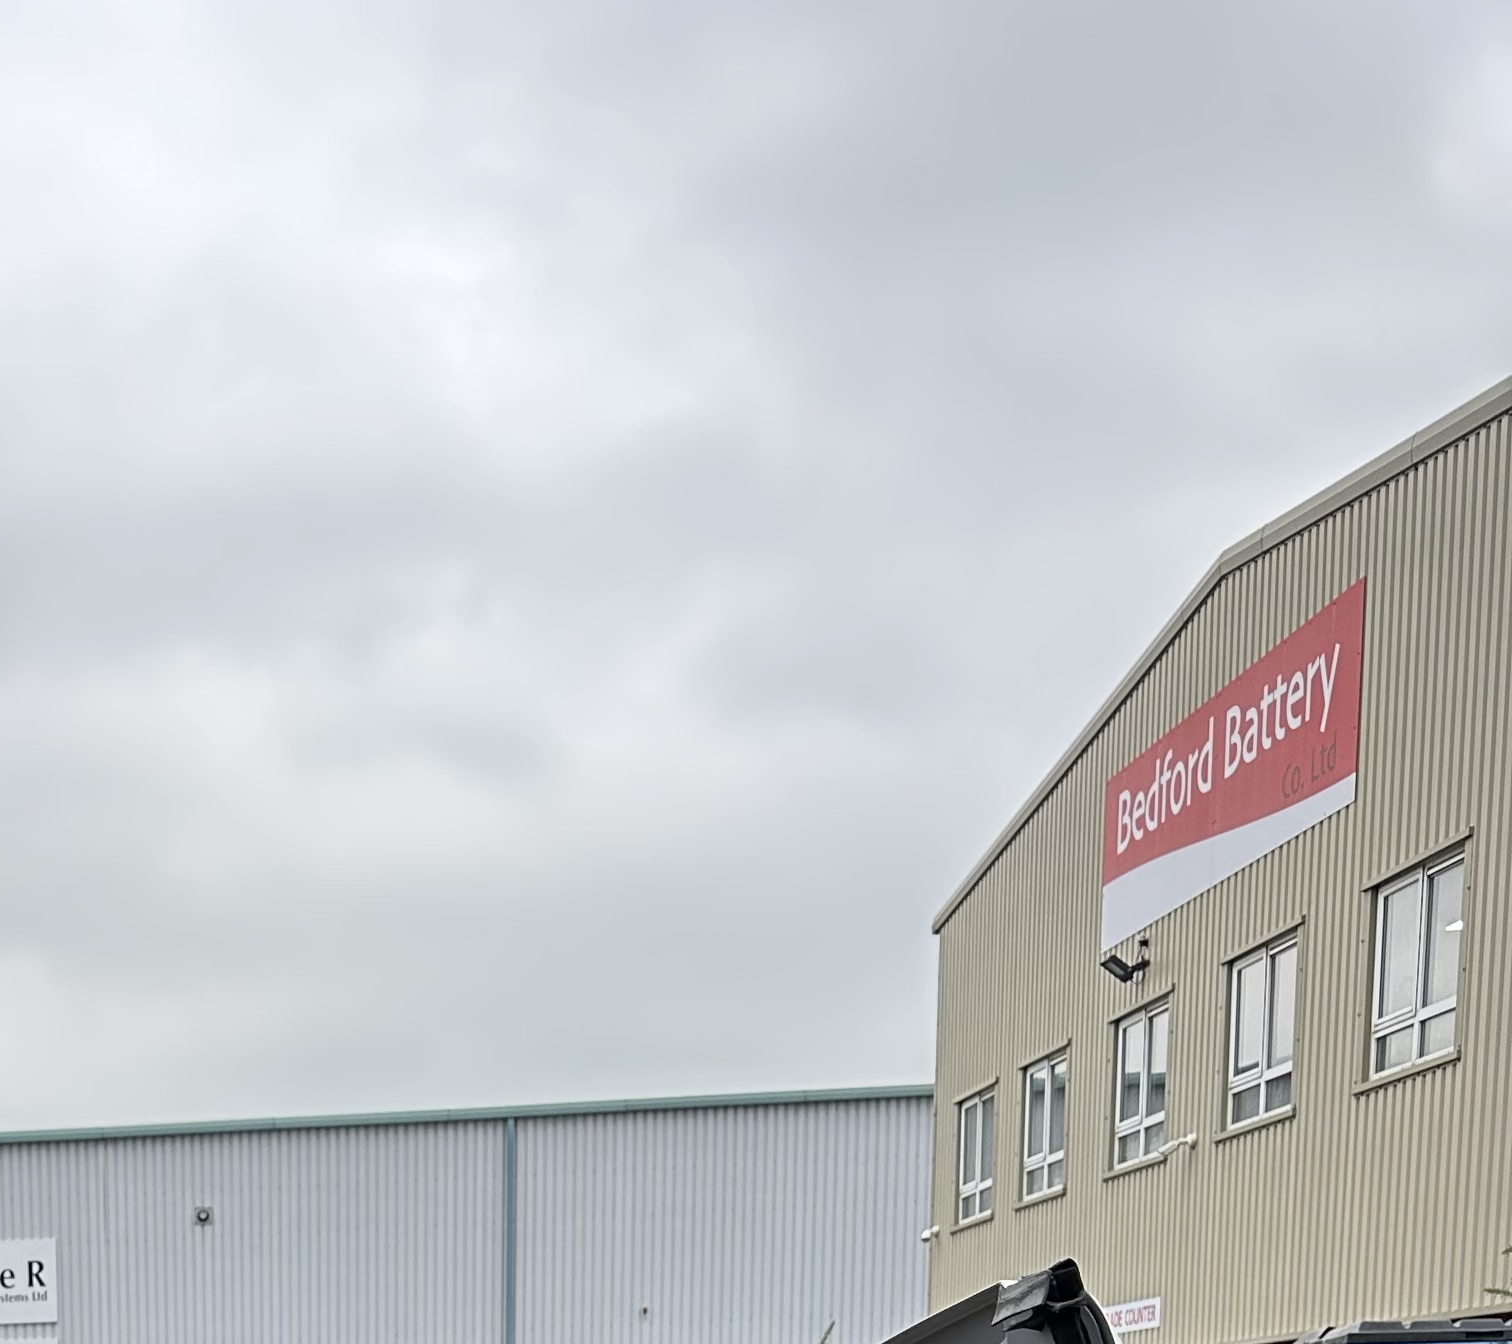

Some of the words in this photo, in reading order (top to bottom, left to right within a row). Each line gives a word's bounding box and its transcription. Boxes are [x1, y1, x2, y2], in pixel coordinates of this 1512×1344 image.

[1116, 715, 1214, 855] Bedford
[1223, 643, 1340, 779] Battery
[1281, 761, 1304, 799] Co.
[1311, 730, 1337, 783] Ltd
[27, 1260, 46, 1288] R
[32, 1290, 48, 1302] Ltd
[1125, 1304, 1156, 1326] COUNTER
